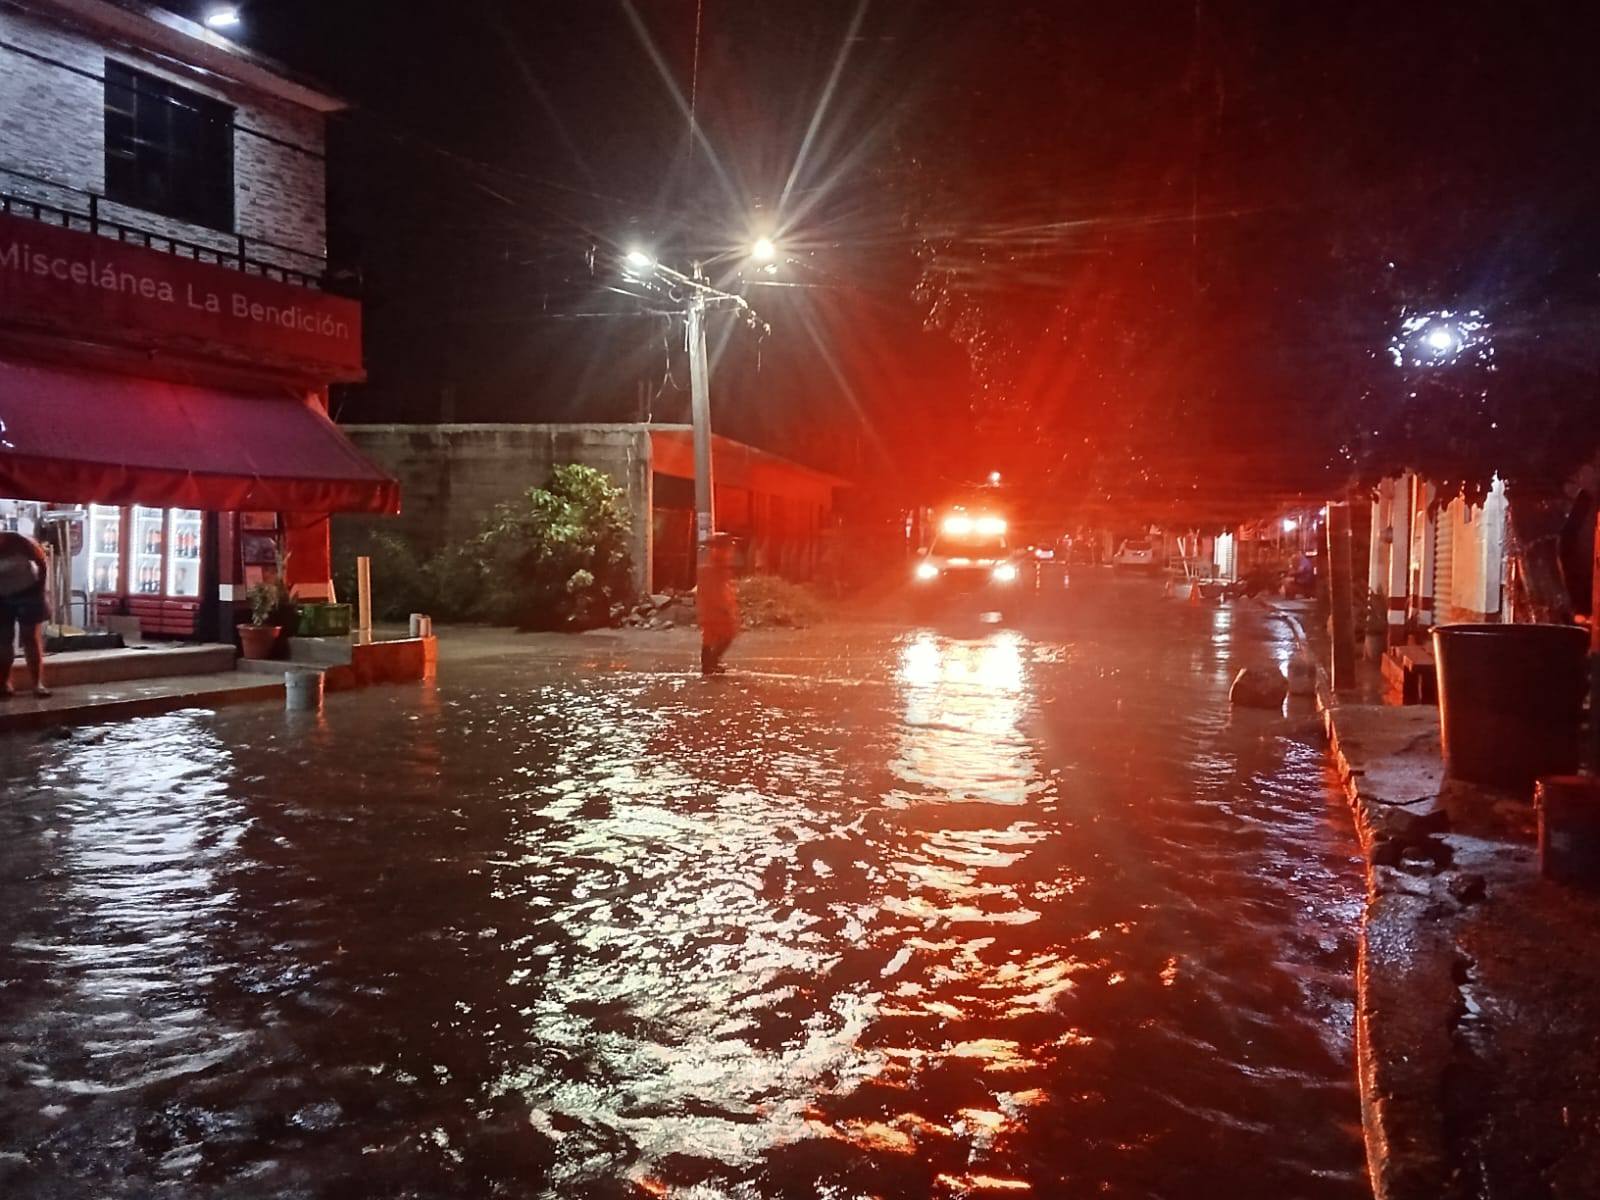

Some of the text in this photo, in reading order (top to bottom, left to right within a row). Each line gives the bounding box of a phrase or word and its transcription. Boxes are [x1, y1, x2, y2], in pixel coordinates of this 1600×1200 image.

[0, 242, 350, 340] Miscelánea La Bendición
